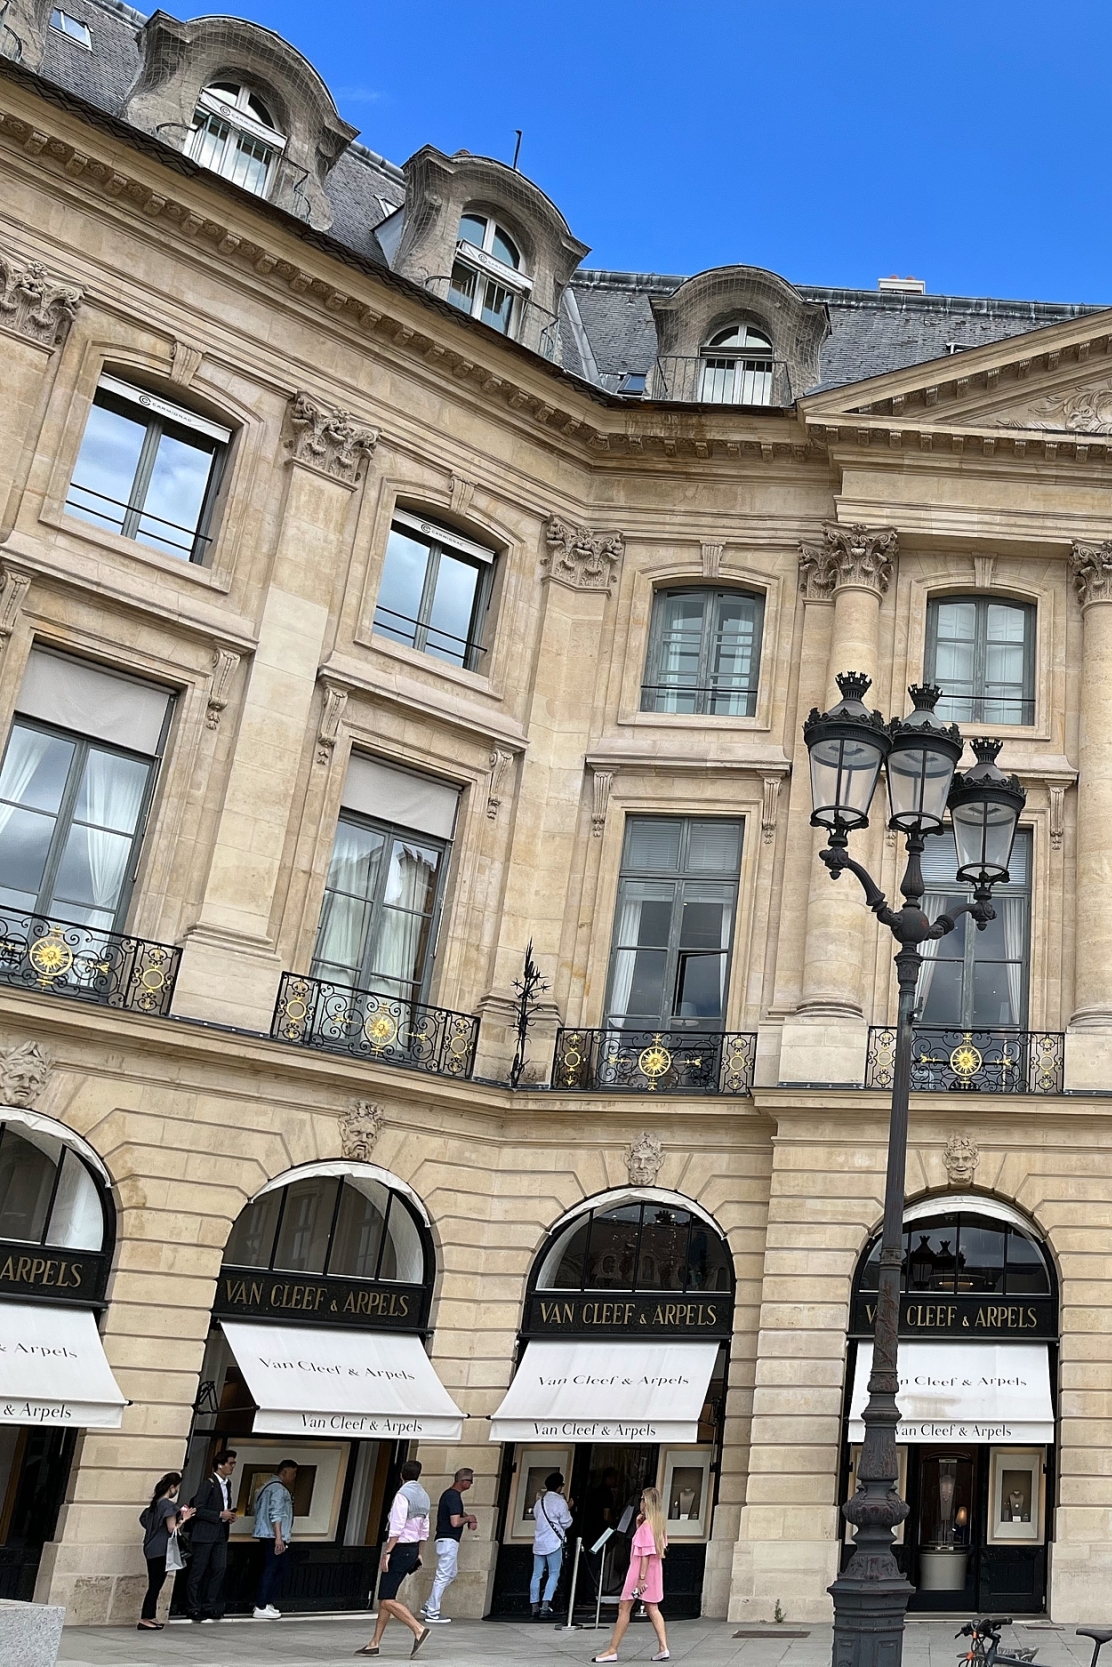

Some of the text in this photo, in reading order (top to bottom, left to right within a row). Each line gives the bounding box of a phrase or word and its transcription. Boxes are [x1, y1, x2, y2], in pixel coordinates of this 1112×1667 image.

[0, 1256, 83, 1288] ARPELS
[225, 1279, 410, 1318] VAN CLEEF & ARPELS
[540, 1302, 718, 1326] VAN CLEEF & ARPELS
[906, 1305, 1038, 1328] CLEEF & ARPELS
[14, 1342, 78, 1359] Arpels
[259, 1357, 416, 1382] Van Cleef & Arpels
[538, 1375, 690, 1387] Van Cleef & Arpels
[914, 1376, 957, 1387] Cleef
[962, 1378, 973, 1387] &
[977, 1376, 1027, 1388] Arpels
[3, 1402, 72, 1422] & Arpels
[302, 1414, 423, 1435] Van Cleef & Arpels
[534, 1423, 656, 1440] Van Cleef & Arpels
[920, 1423, 957, 1437] Cleef
[958, 1426, 968, 1437] &
[971, 1424, 1012, 1441] Arpels
